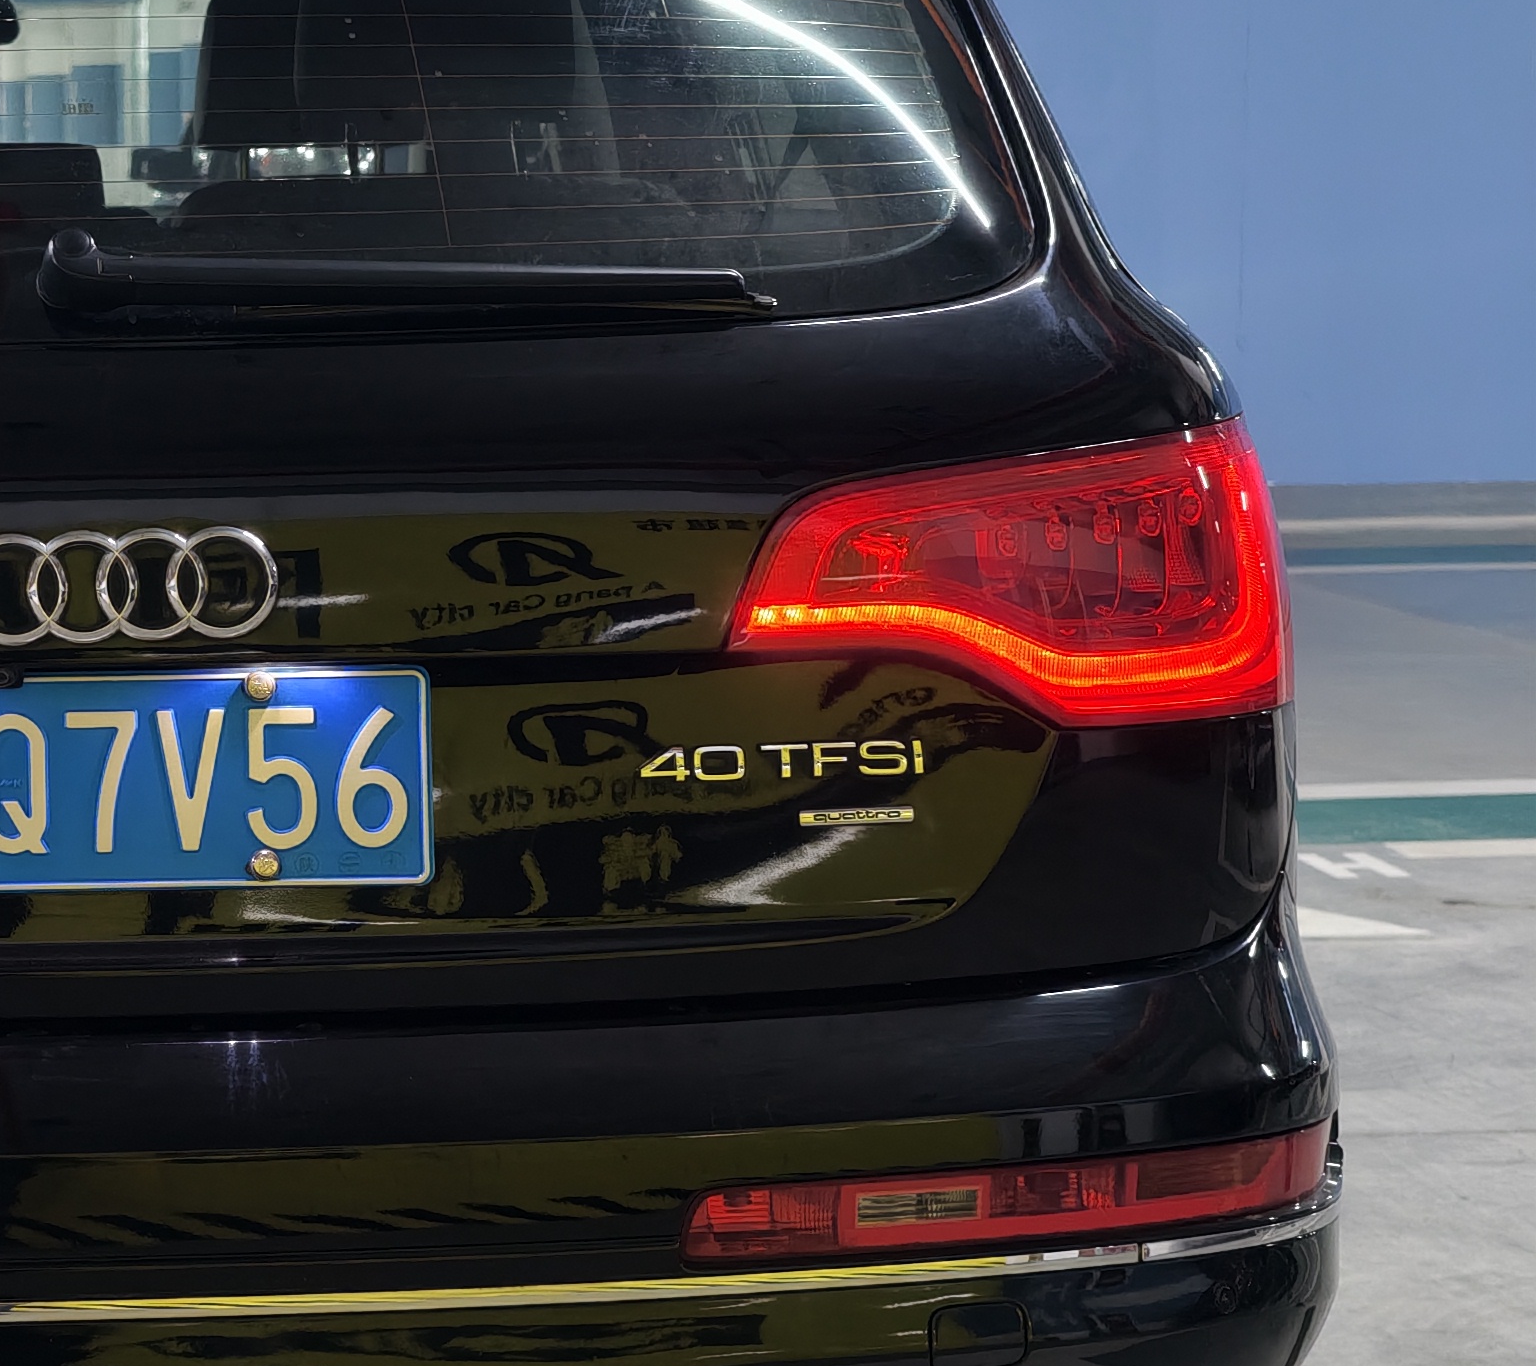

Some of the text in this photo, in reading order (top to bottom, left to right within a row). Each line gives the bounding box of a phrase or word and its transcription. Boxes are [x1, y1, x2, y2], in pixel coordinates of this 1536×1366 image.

[637, 739, 925, 782] 40 TFSI
[812, 809, 902, 824] quattro
